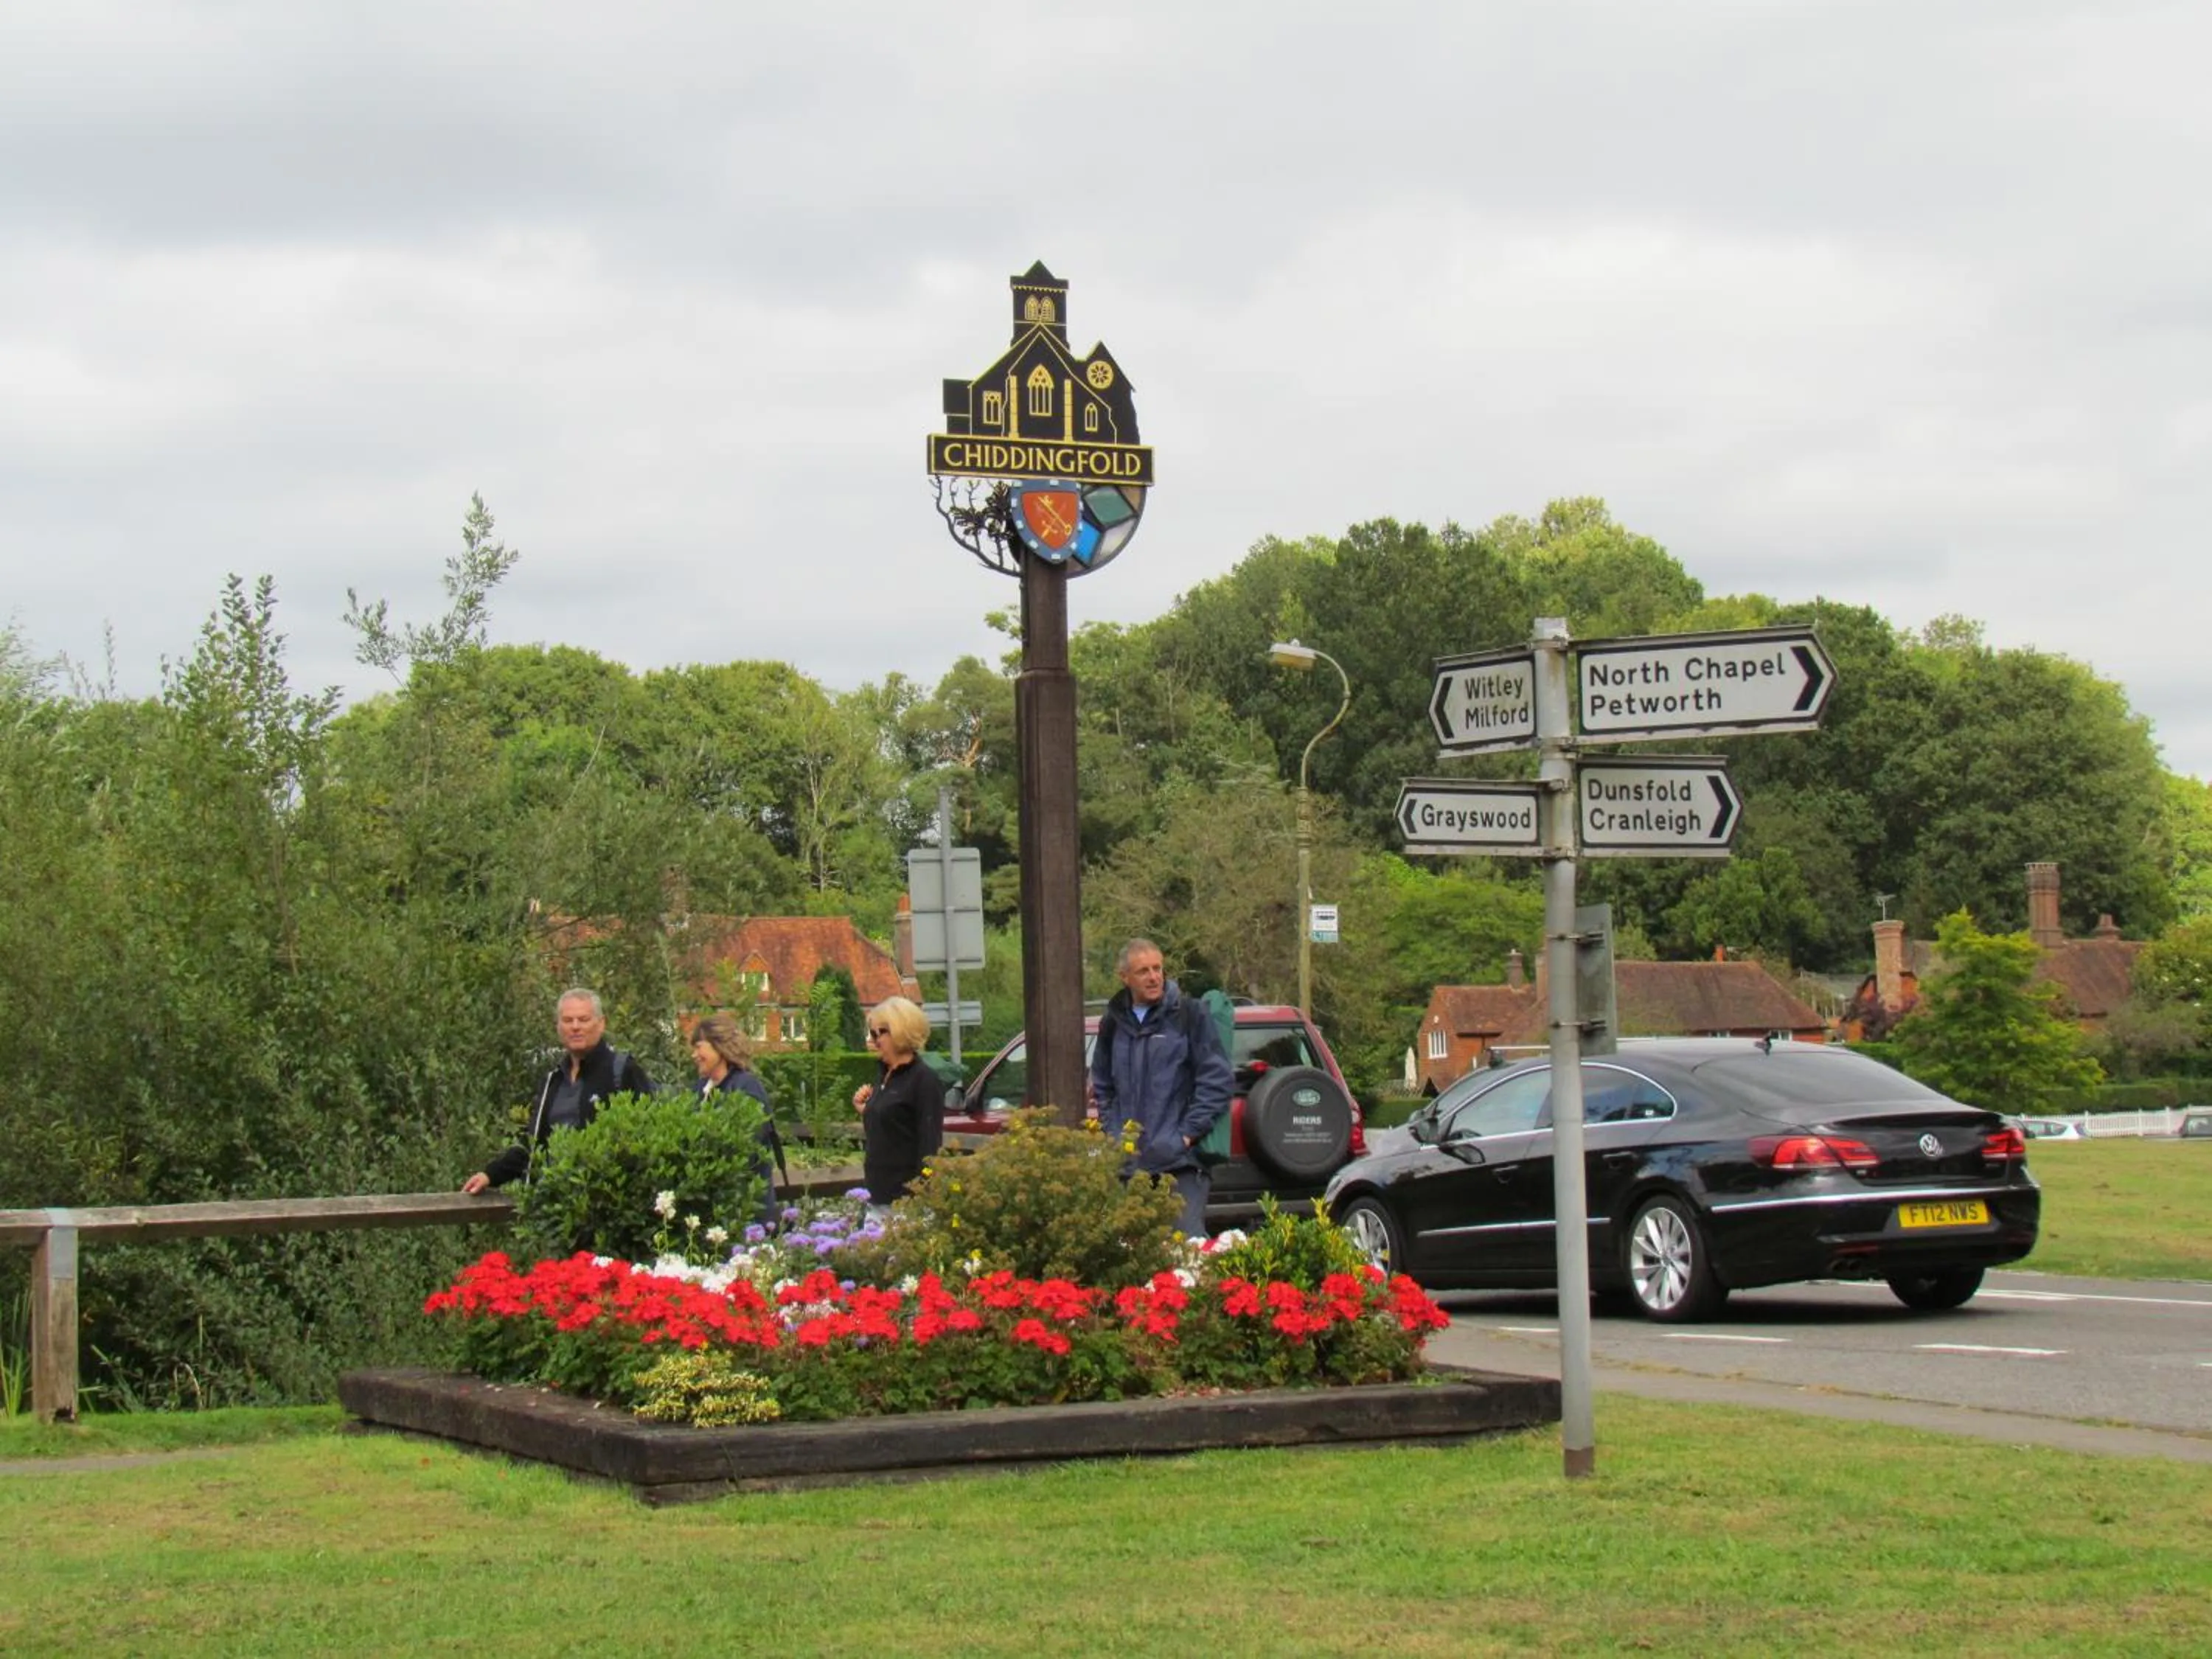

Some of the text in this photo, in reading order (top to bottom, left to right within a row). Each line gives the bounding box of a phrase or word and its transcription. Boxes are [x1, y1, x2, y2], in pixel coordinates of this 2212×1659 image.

[943, 443, 1141, 476] CHIDDINGFOLD
[1590, 653, 1785, 686] North Chapel
[1464, 676, 1523, 700] Witley
[1590, 688, 1722, 716] Petworth
[1464, 703, 1529, 729] Milford
[1588, 779, 1691, 801] Dunsfold
[1421, 804, 1531, 832] Grayswood
[1590, 807, 1701, 835] Cranleigh
